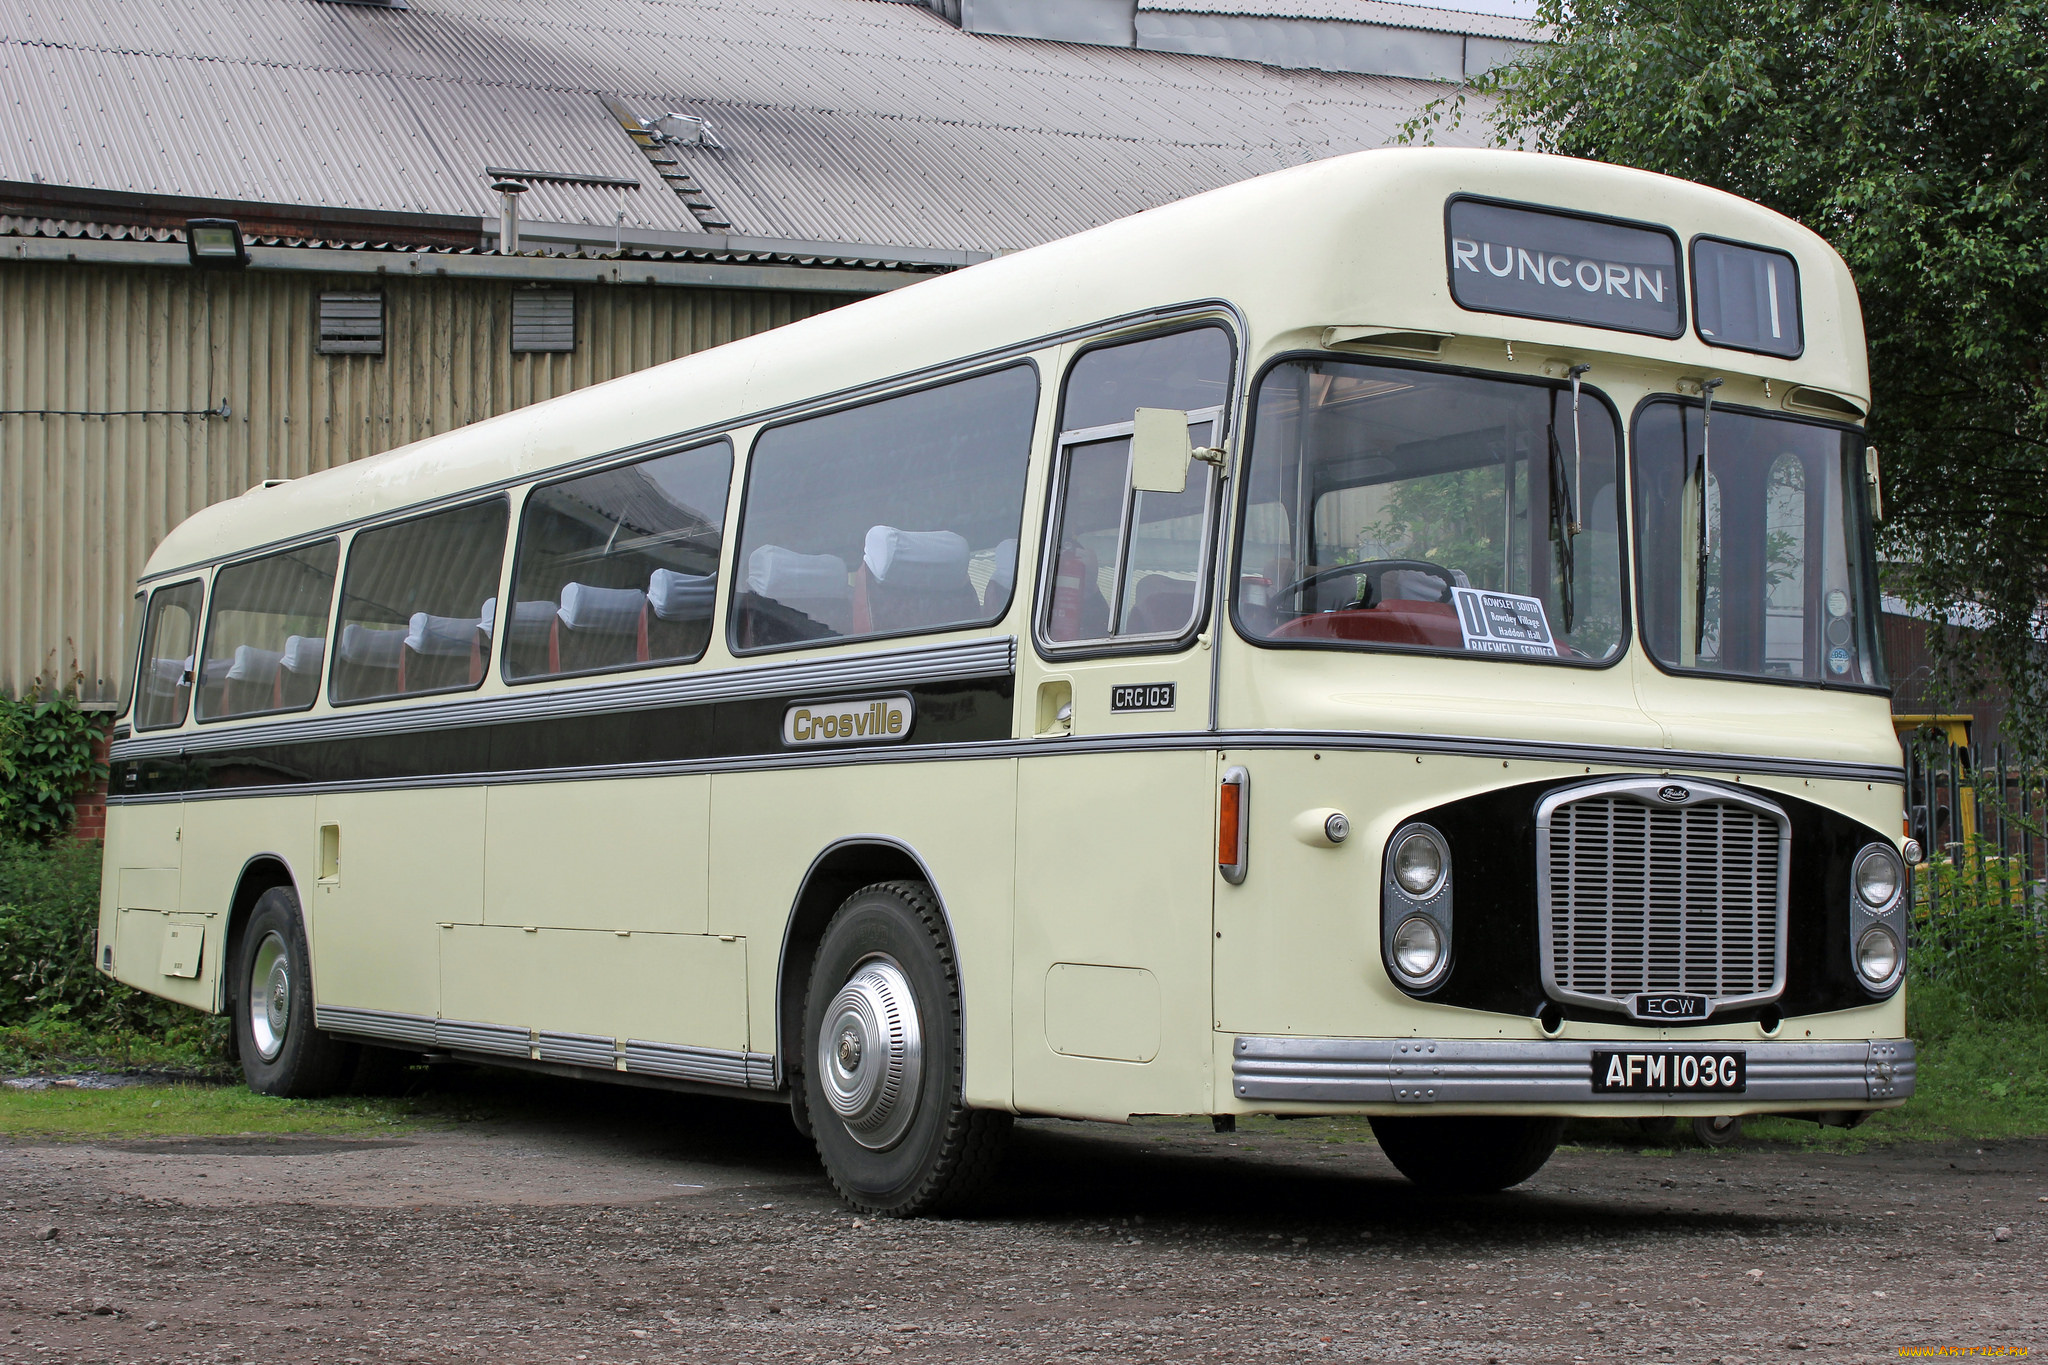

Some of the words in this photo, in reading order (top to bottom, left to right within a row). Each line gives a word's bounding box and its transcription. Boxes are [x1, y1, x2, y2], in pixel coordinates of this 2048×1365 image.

[1452, 236, 1664, 303] RUNCORN
[1766, 260, 1781, 339] 1
[1482, 596, 1515, 610] ROWSLEY
[1516, 601, 1539, 614] SOUTH
[1490, 611, 1517, 626] Rowsley
[1517, 614, 1540, 629] Village
[1498, 626, 1525, 639] Haddon
[1526, 630, 1541, 641] Hall
[1115, 687, 1170, 708] CRG103
[793, 702, 903, 741] Crosville
[1647, 998, 1695, 1015] ECW
[1605, 1053, 1666, 1088] AFM
